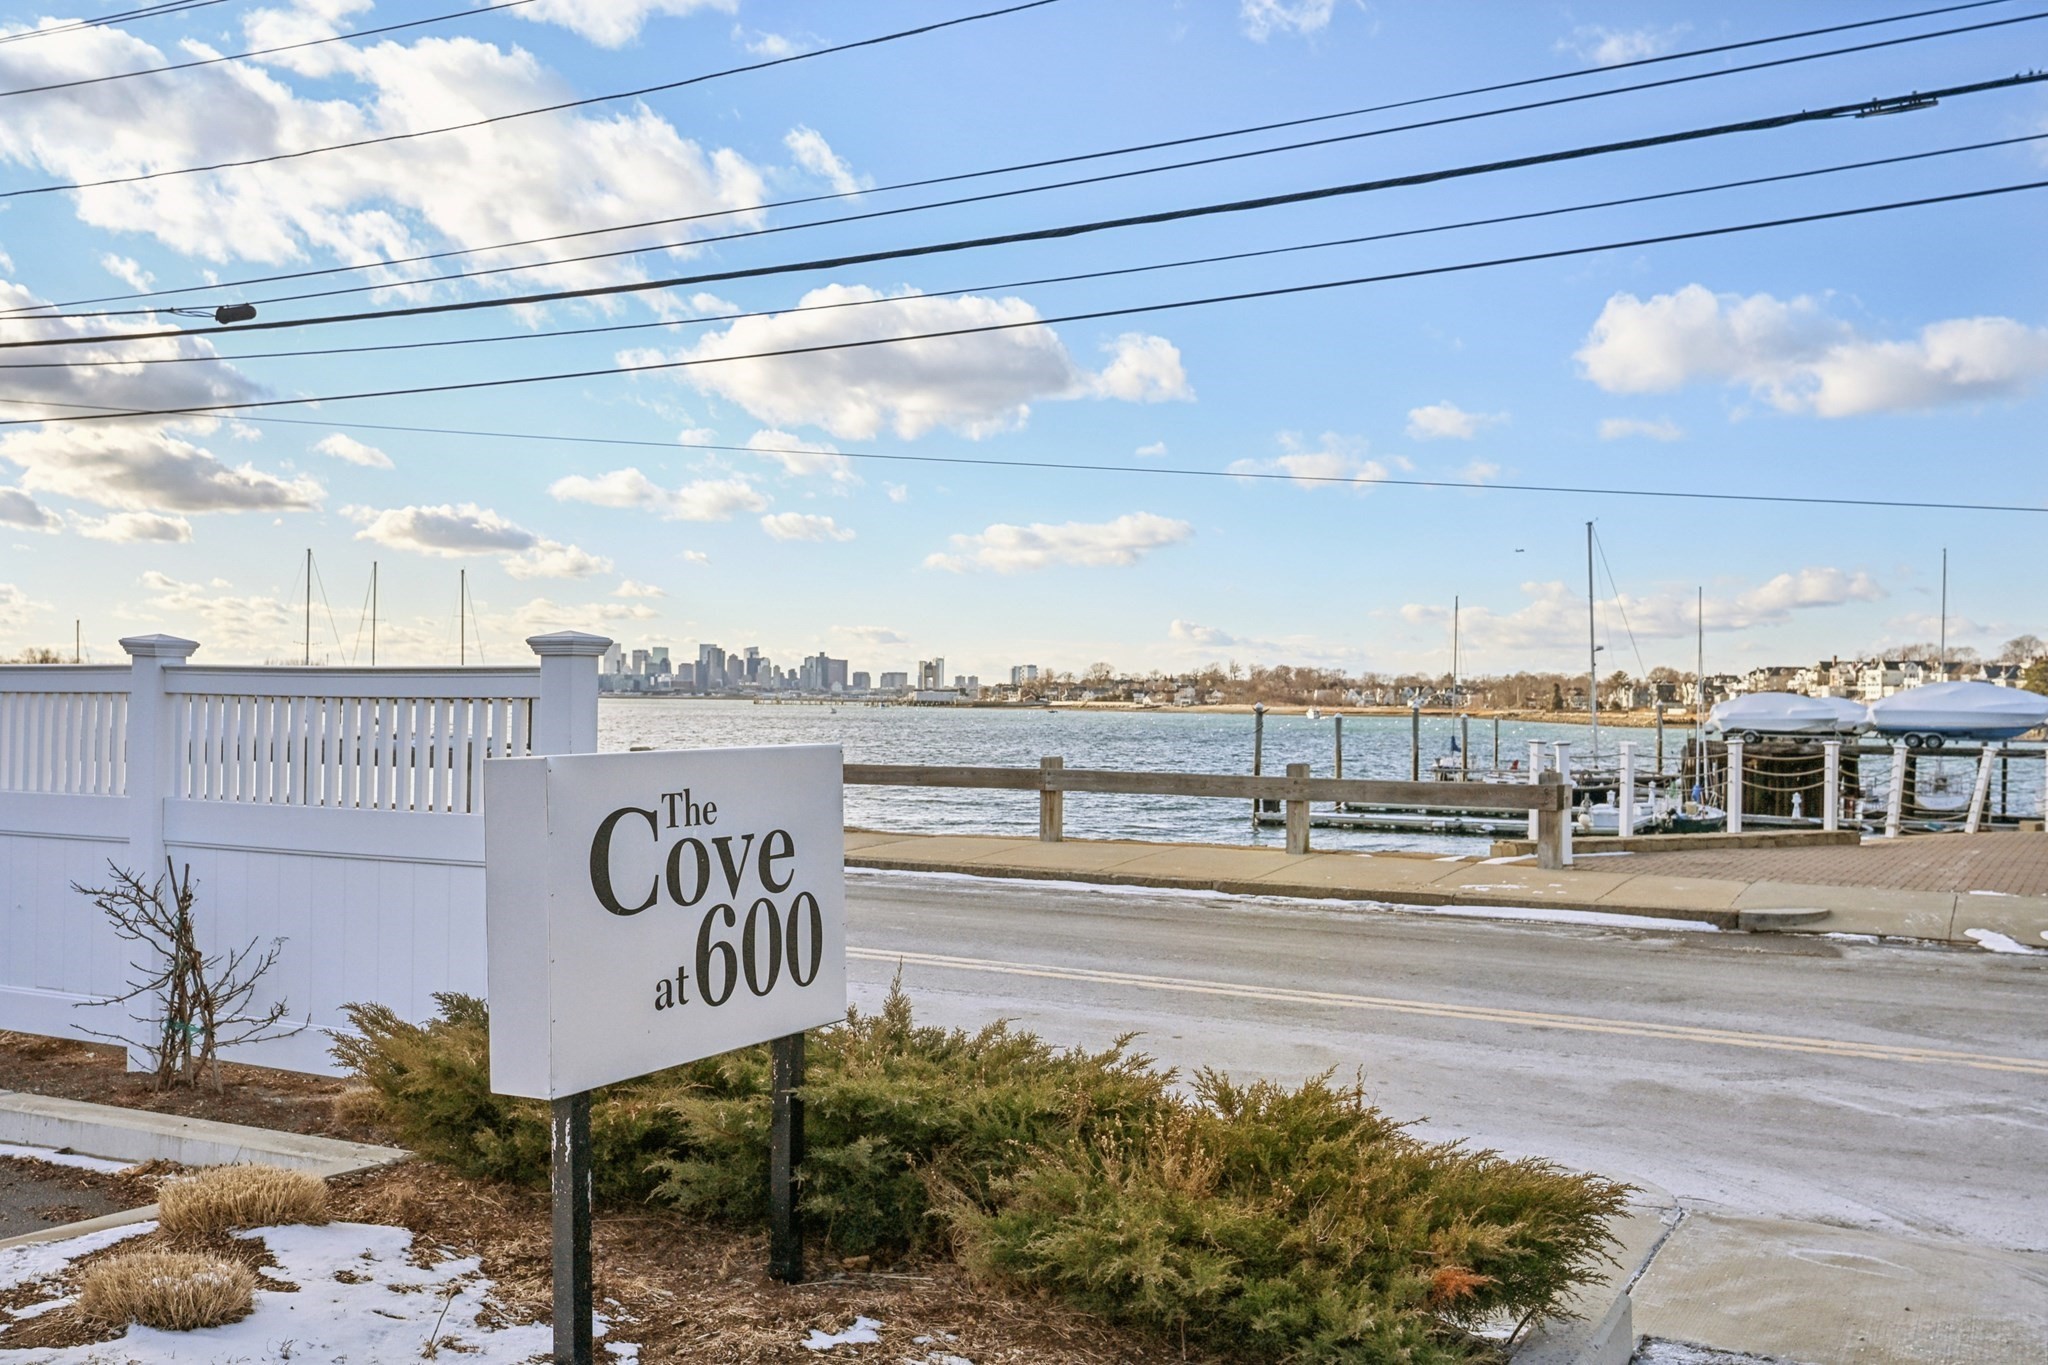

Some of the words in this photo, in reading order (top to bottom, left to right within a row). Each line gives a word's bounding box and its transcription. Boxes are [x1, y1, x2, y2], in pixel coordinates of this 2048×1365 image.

[590, 807, 795, 916] Cove
[661, 788, 718, 828] The
[655, 966, 690, 1011] at
[695, 891, 823, 1007] 600
